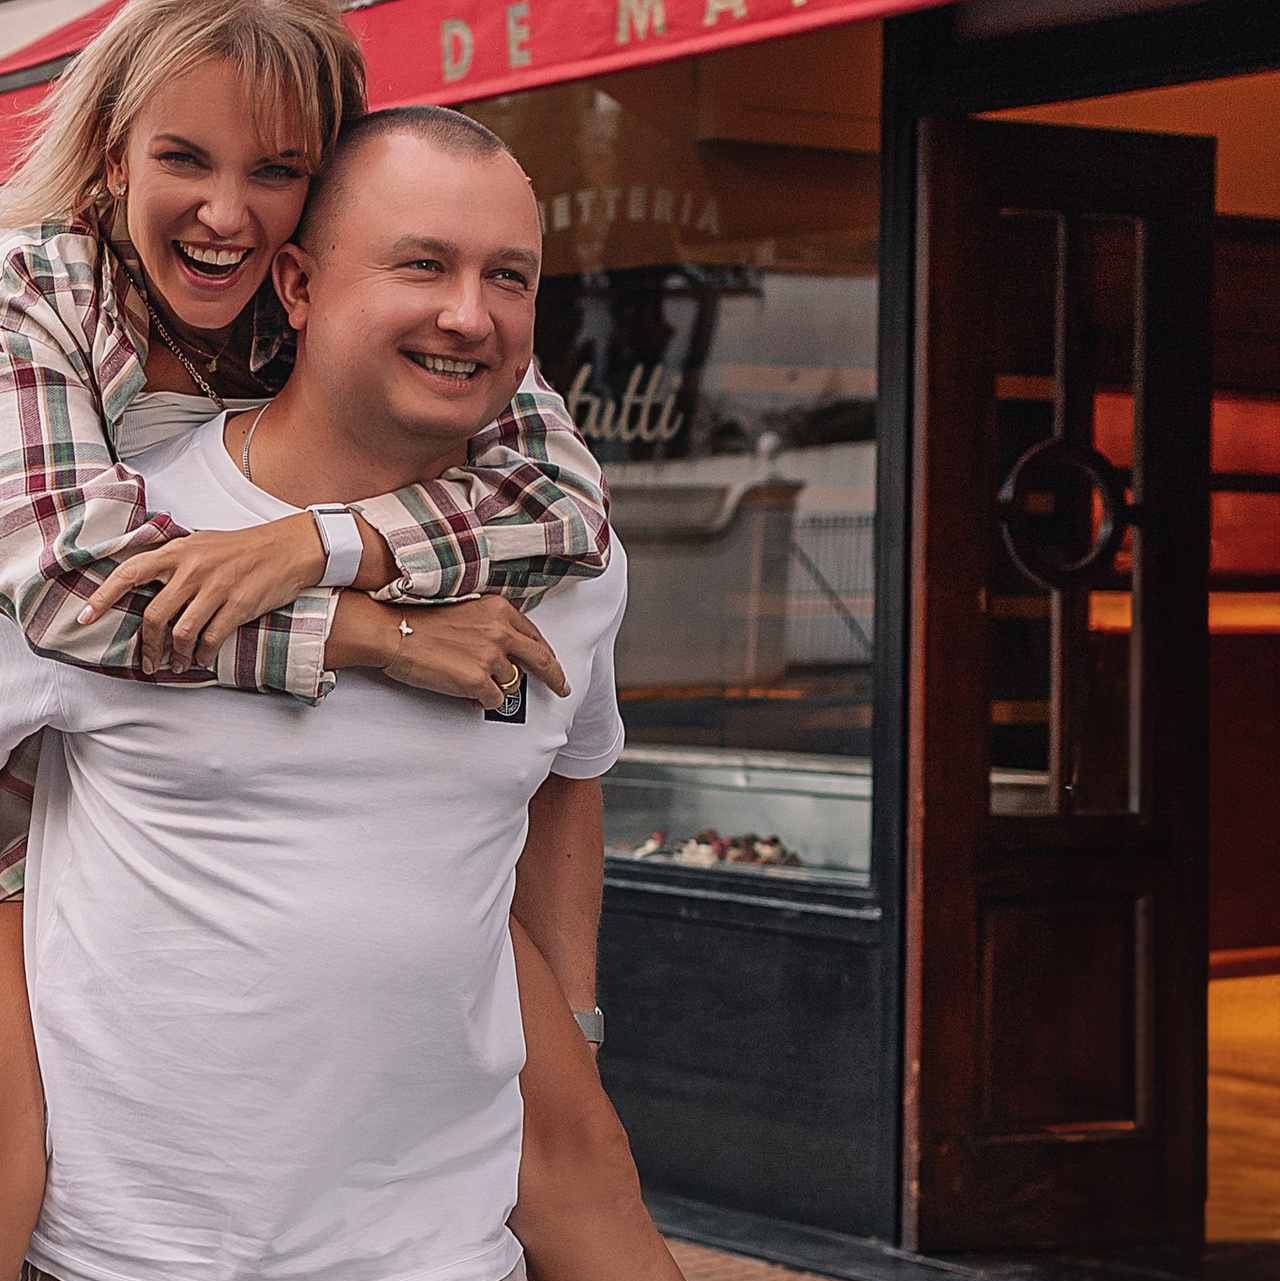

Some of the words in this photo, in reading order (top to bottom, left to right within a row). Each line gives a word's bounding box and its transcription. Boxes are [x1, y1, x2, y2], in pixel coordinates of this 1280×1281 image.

[441, 1, 532, 83] DE
[540, 186, 720, 236] ETTERIA
[568, 363, 685, 441] tutti
